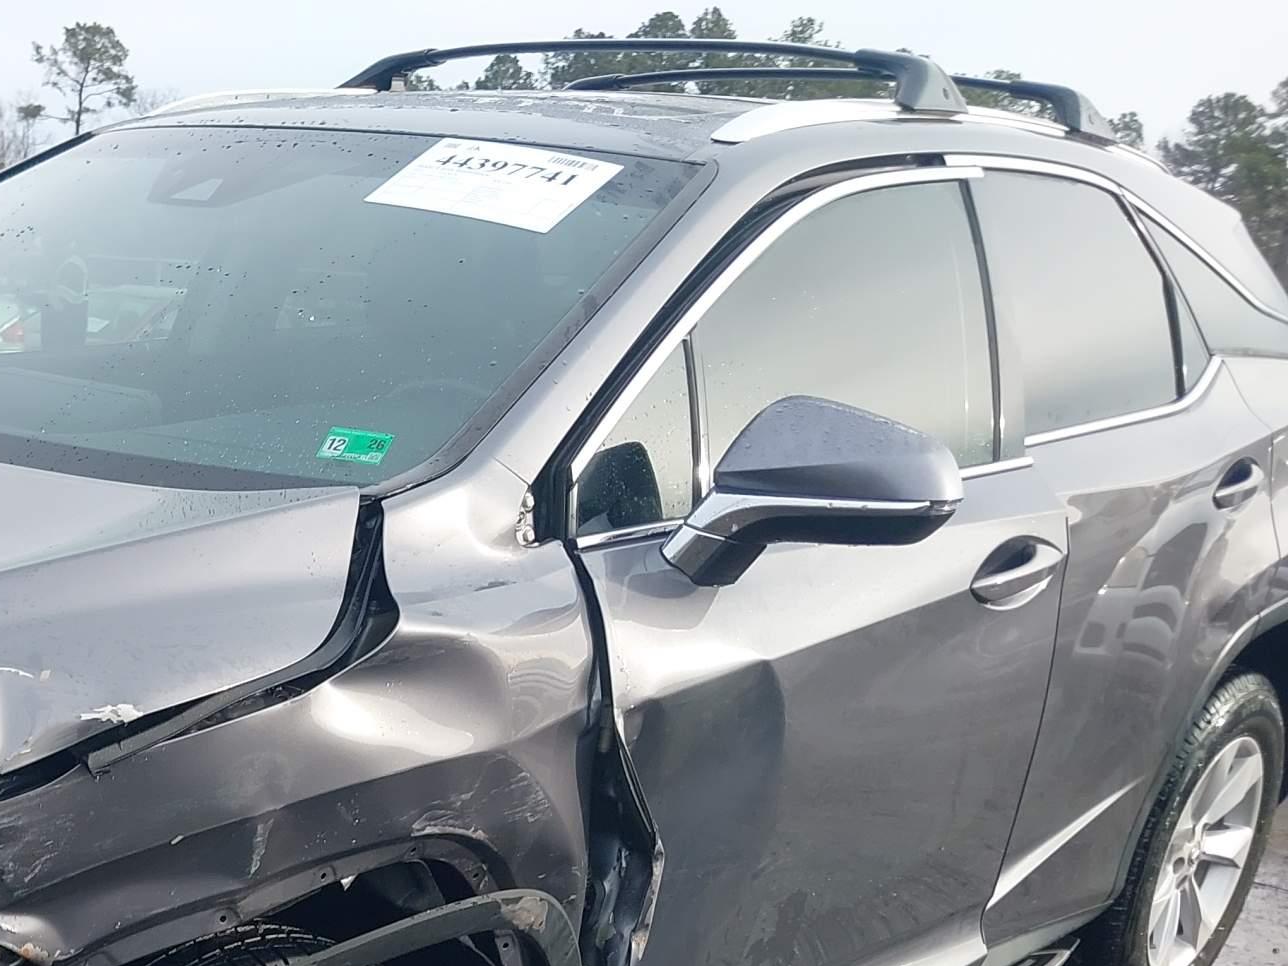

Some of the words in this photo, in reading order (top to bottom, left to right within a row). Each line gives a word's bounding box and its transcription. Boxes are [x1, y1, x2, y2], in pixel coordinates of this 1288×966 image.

[435, 154, 579, 185] 44397741
[327, 438, 347, 452] 12
[367, 439, 386, 450] 26
